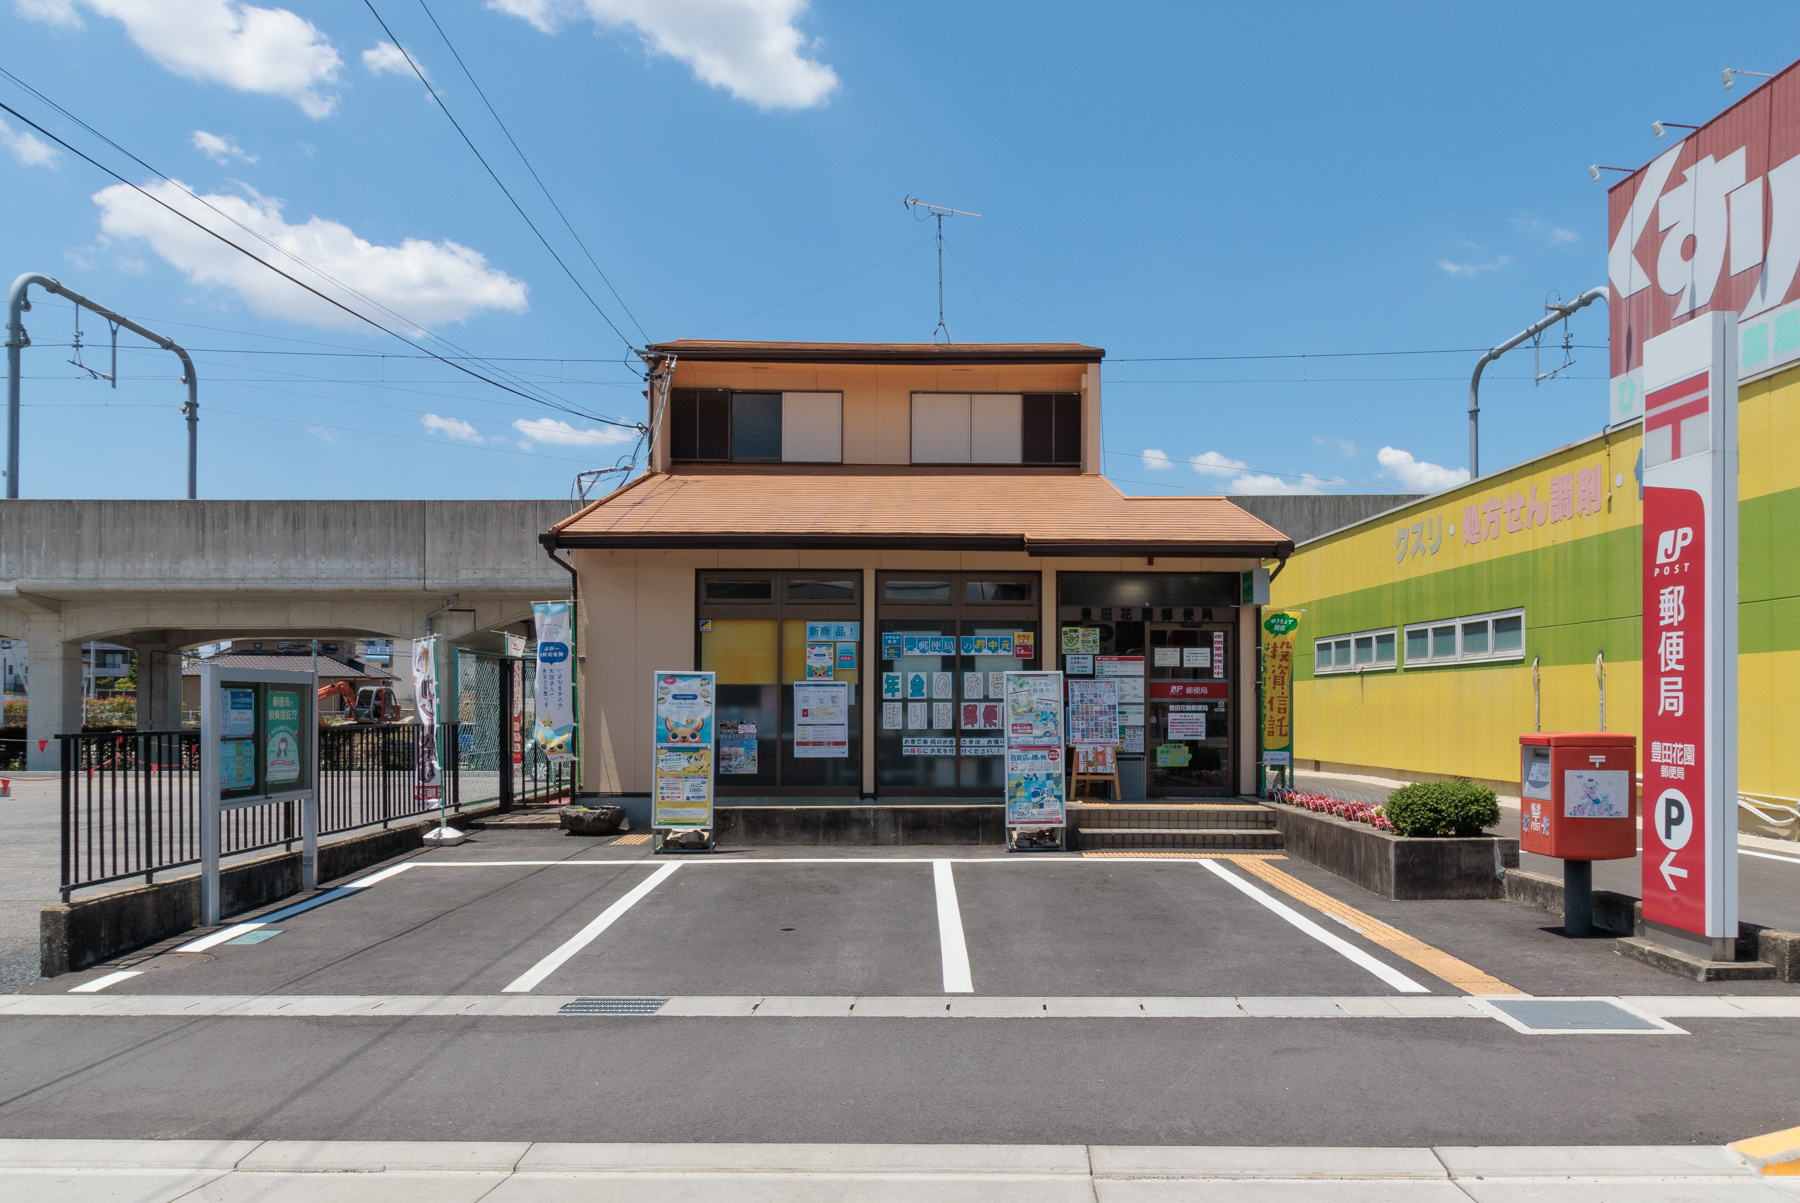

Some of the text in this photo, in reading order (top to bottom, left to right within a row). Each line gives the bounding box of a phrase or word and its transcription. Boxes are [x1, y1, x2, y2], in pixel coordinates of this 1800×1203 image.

[1608, 139, 1800, 324] くすり
[1654, 563, 1690, 577] POST
[1658, 586, 1685, 717] 郵便局
[1186, 687, 1208, 695] 郵便局
[1268, 641, 1292, 737] 投資信託
[1651, 741, 1695, 766] 豊田花園
[1660, 765, 1685, 780] 郵便局
[1530, 821, 1541, 831] POST
[1665, 797, 1685, 840] P
